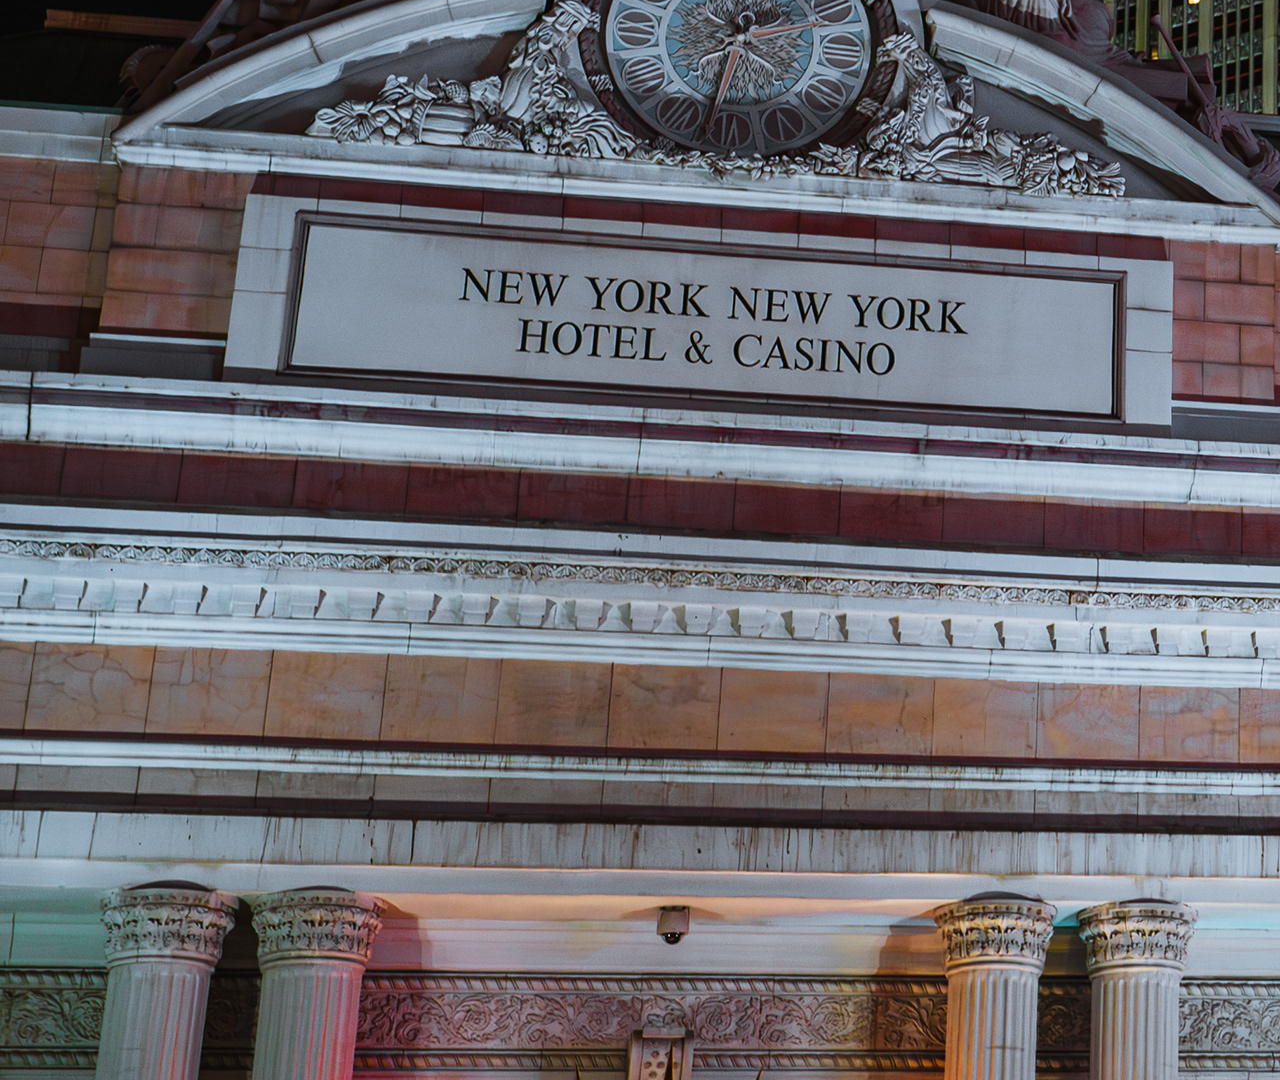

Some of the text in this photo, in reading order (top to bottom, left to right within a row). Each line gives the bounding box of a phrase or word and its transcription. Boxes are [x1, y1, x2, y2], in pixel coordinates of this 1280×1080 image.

[459, 268, 968, 334] NEW YORK NEW YORK
[515, 318, 895, 375] HOTEL & CASINO
